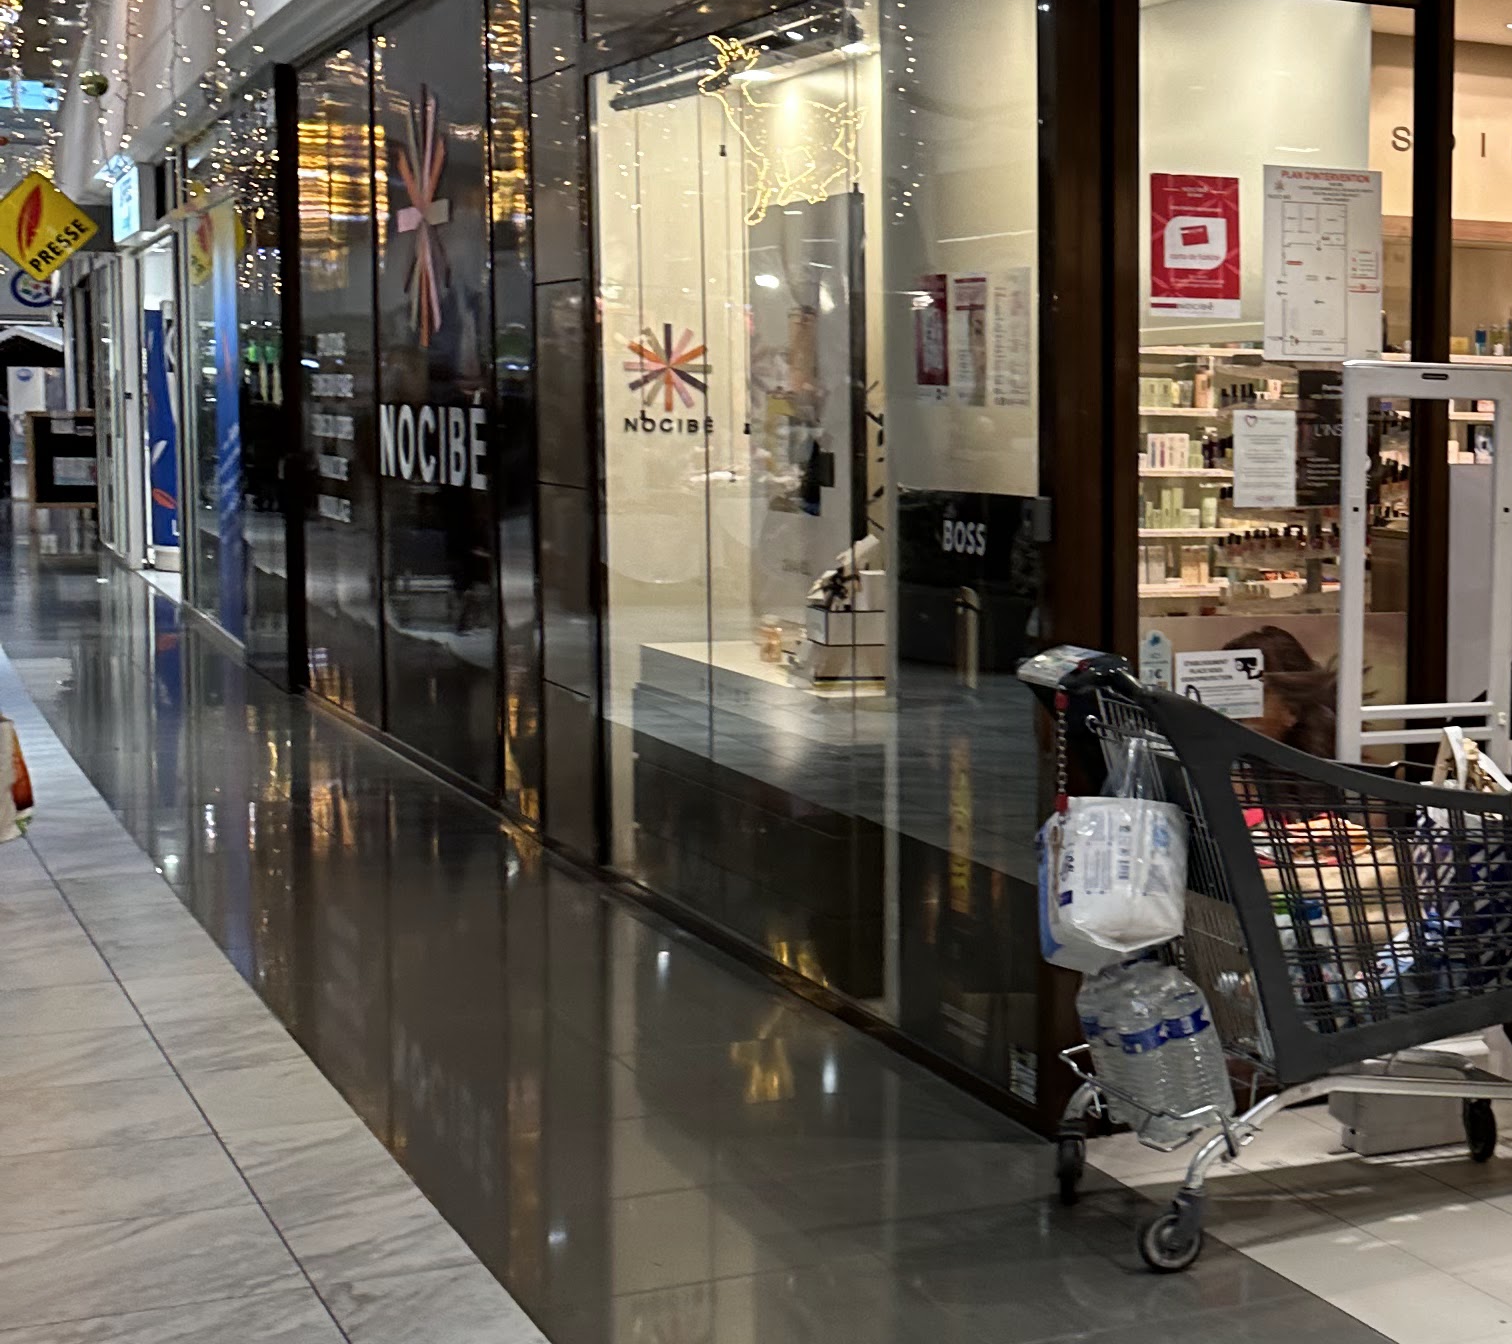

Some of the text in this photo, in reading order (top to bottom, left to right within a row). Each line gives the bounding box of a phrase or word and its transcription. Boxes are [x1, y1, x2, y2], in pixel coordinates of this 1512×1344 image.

[29, 218, 89, 275] PRESSE
[380, 389, 488, 491] NOCIBÉ
[623, 414, 715, 436] NOCIBÉ
[942, 519, 987, 556] BOSS
